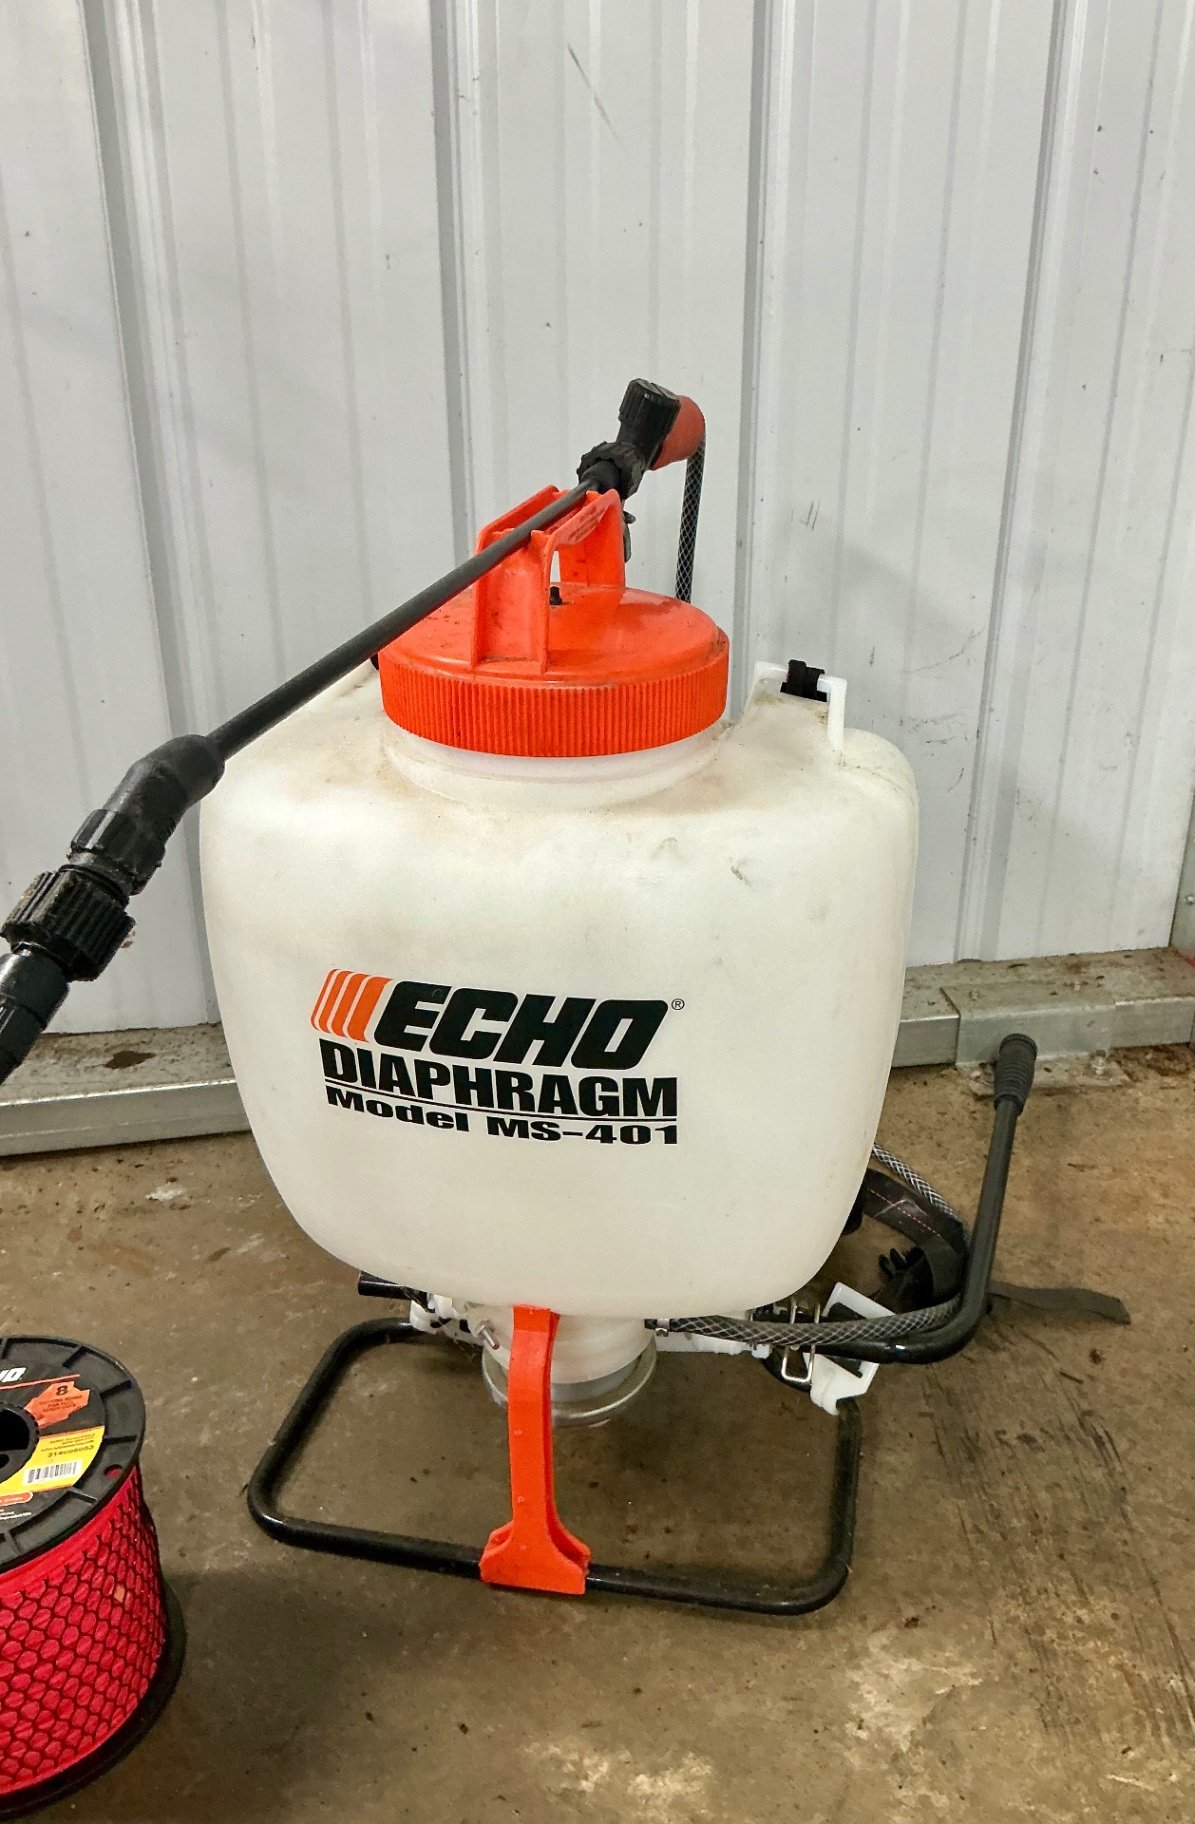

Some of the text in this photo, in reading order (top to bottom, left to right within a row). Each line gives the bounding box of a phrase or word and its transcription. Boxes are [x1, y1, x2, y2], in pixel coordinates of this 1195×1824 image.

[373, 980, 669, 1070] ECHO
[318, 1038, 679, 1118] DIAPHRAGM
[325, 1085, 679, 1145] Model MS-401
[55, 1385, 69, 1396] 8
